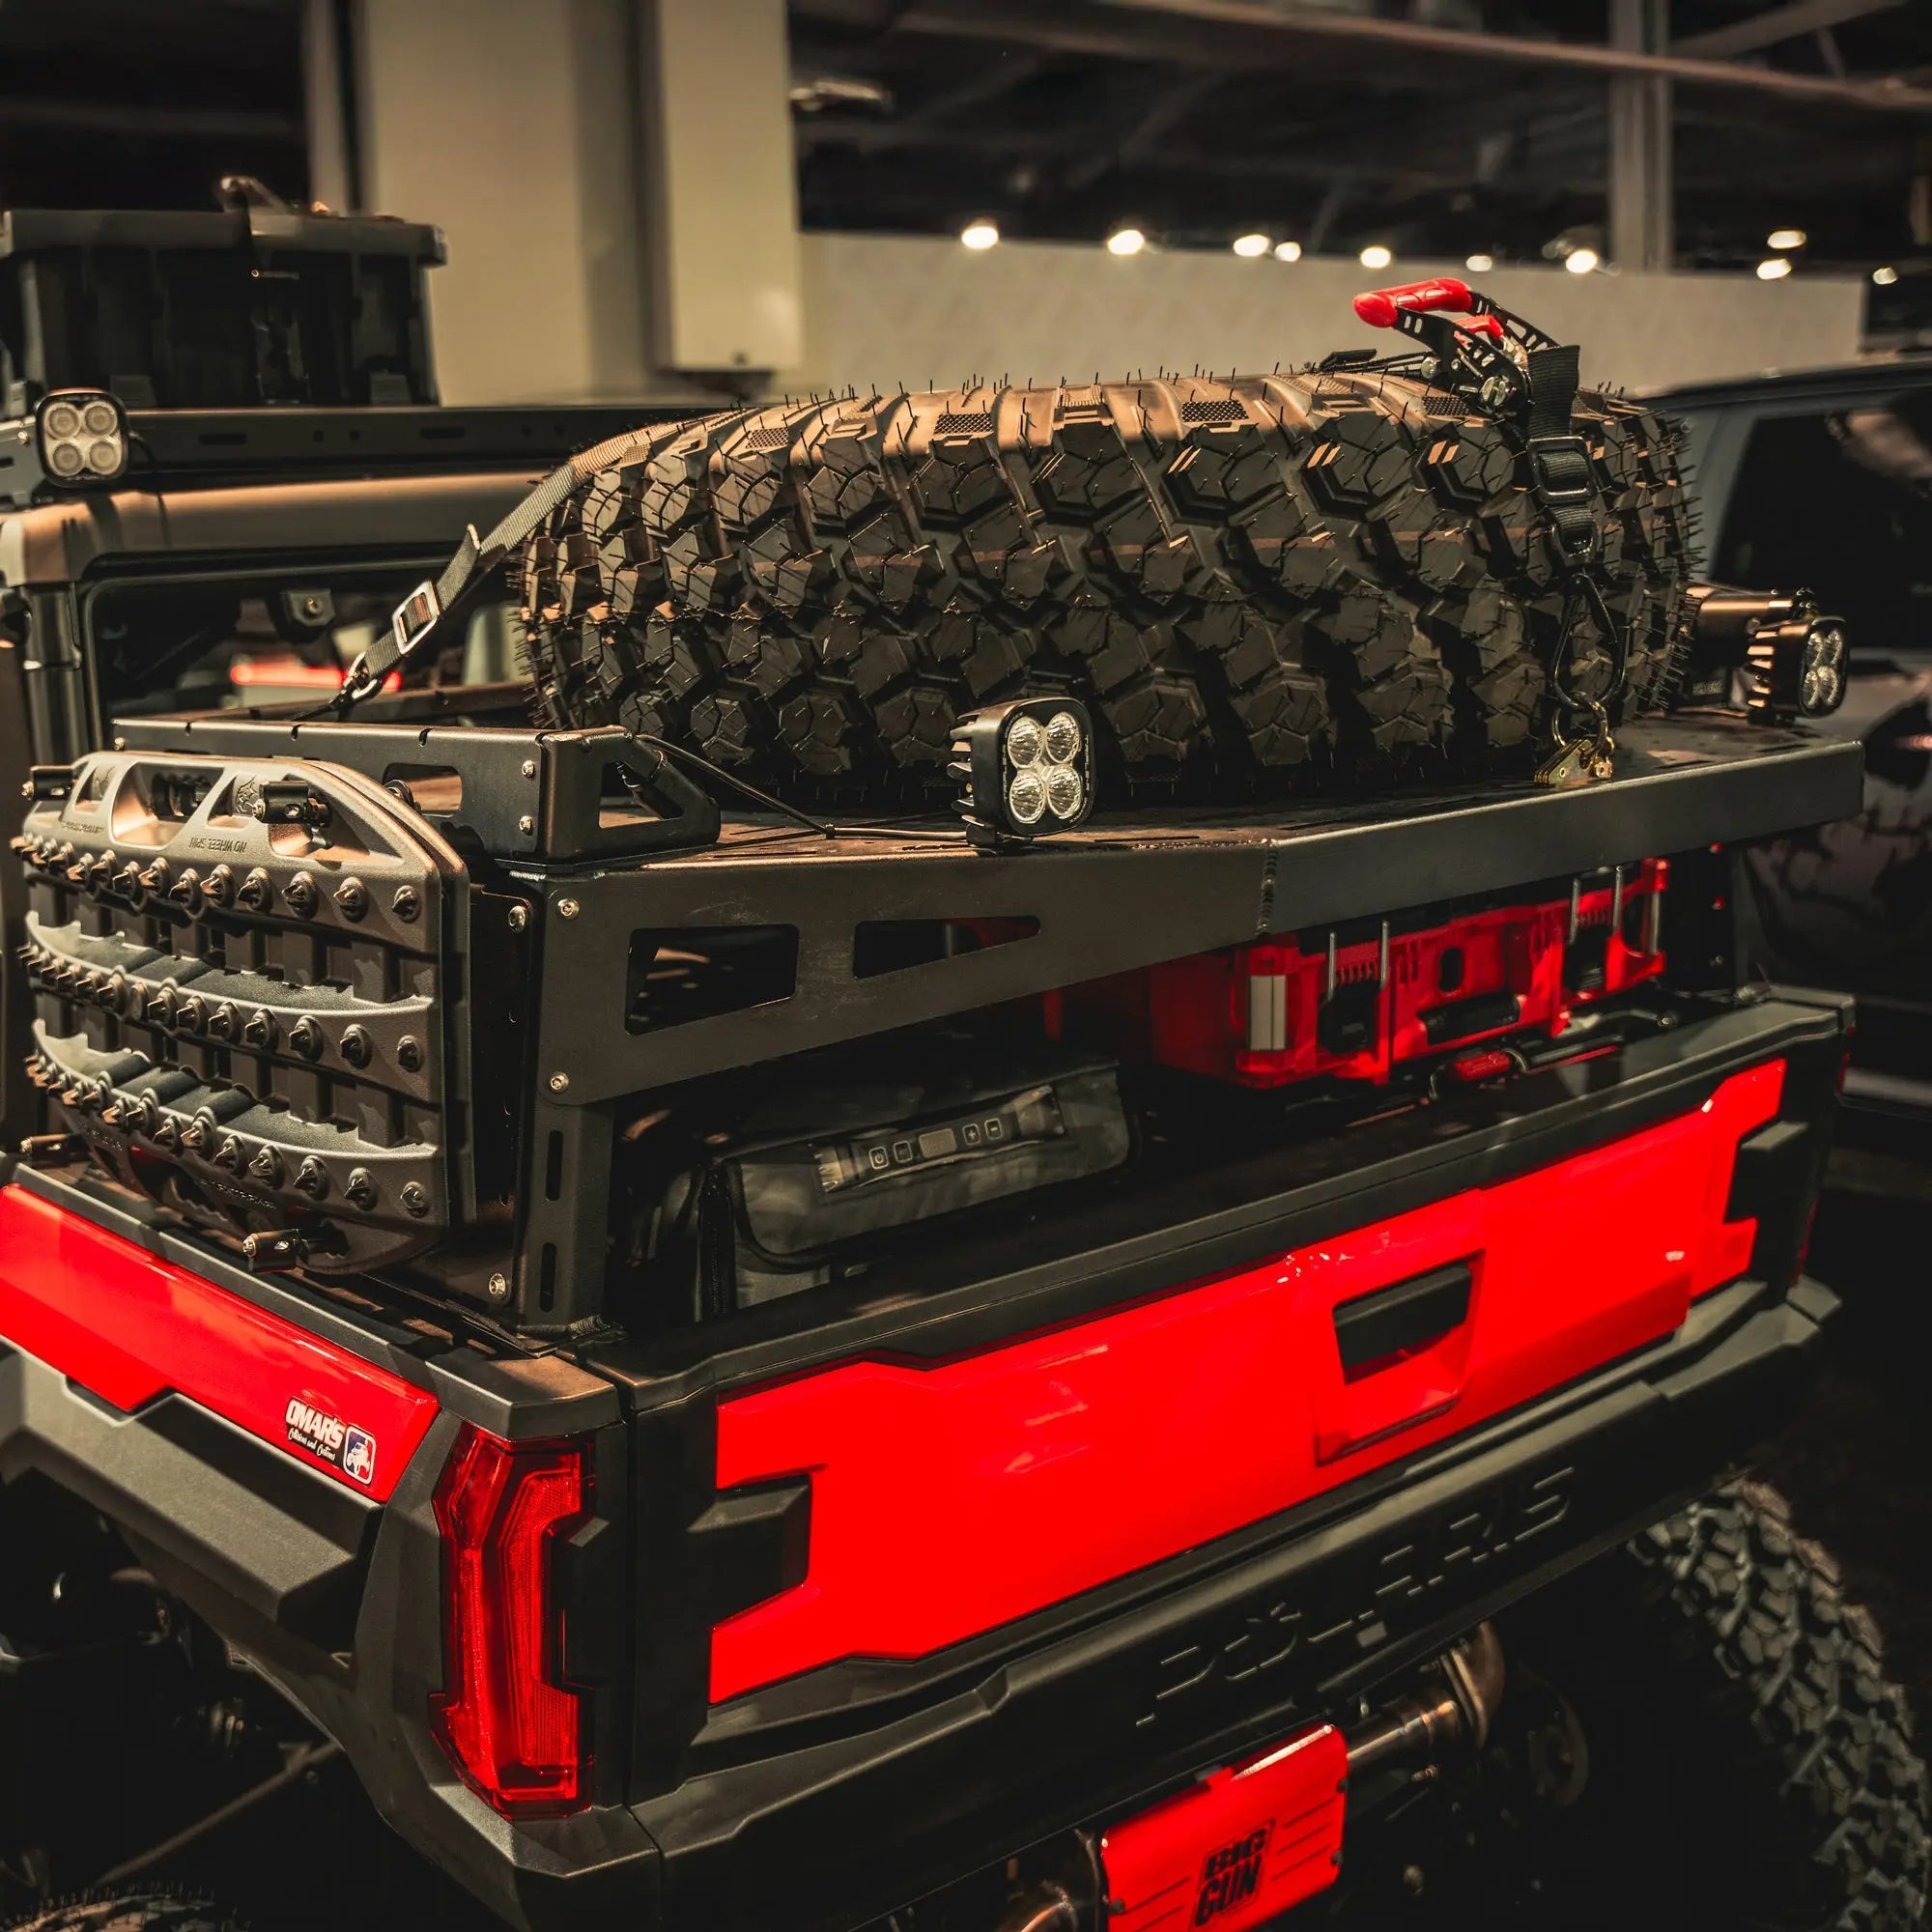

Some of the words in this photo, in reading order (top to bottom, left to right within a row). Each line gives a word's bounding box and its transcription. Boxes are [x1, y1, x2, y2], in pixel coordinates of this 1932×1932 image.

[188, 837, 207, 849] SPIN
[208, 838, 234, 852] WHEEL
[233, 840, 247, 853] NO
[285, 1398, 347, 1450] OMAR'S
[1204, 1828, 1267, 1880] BIG
[1194, 1853, 1263, 1926] GUN
